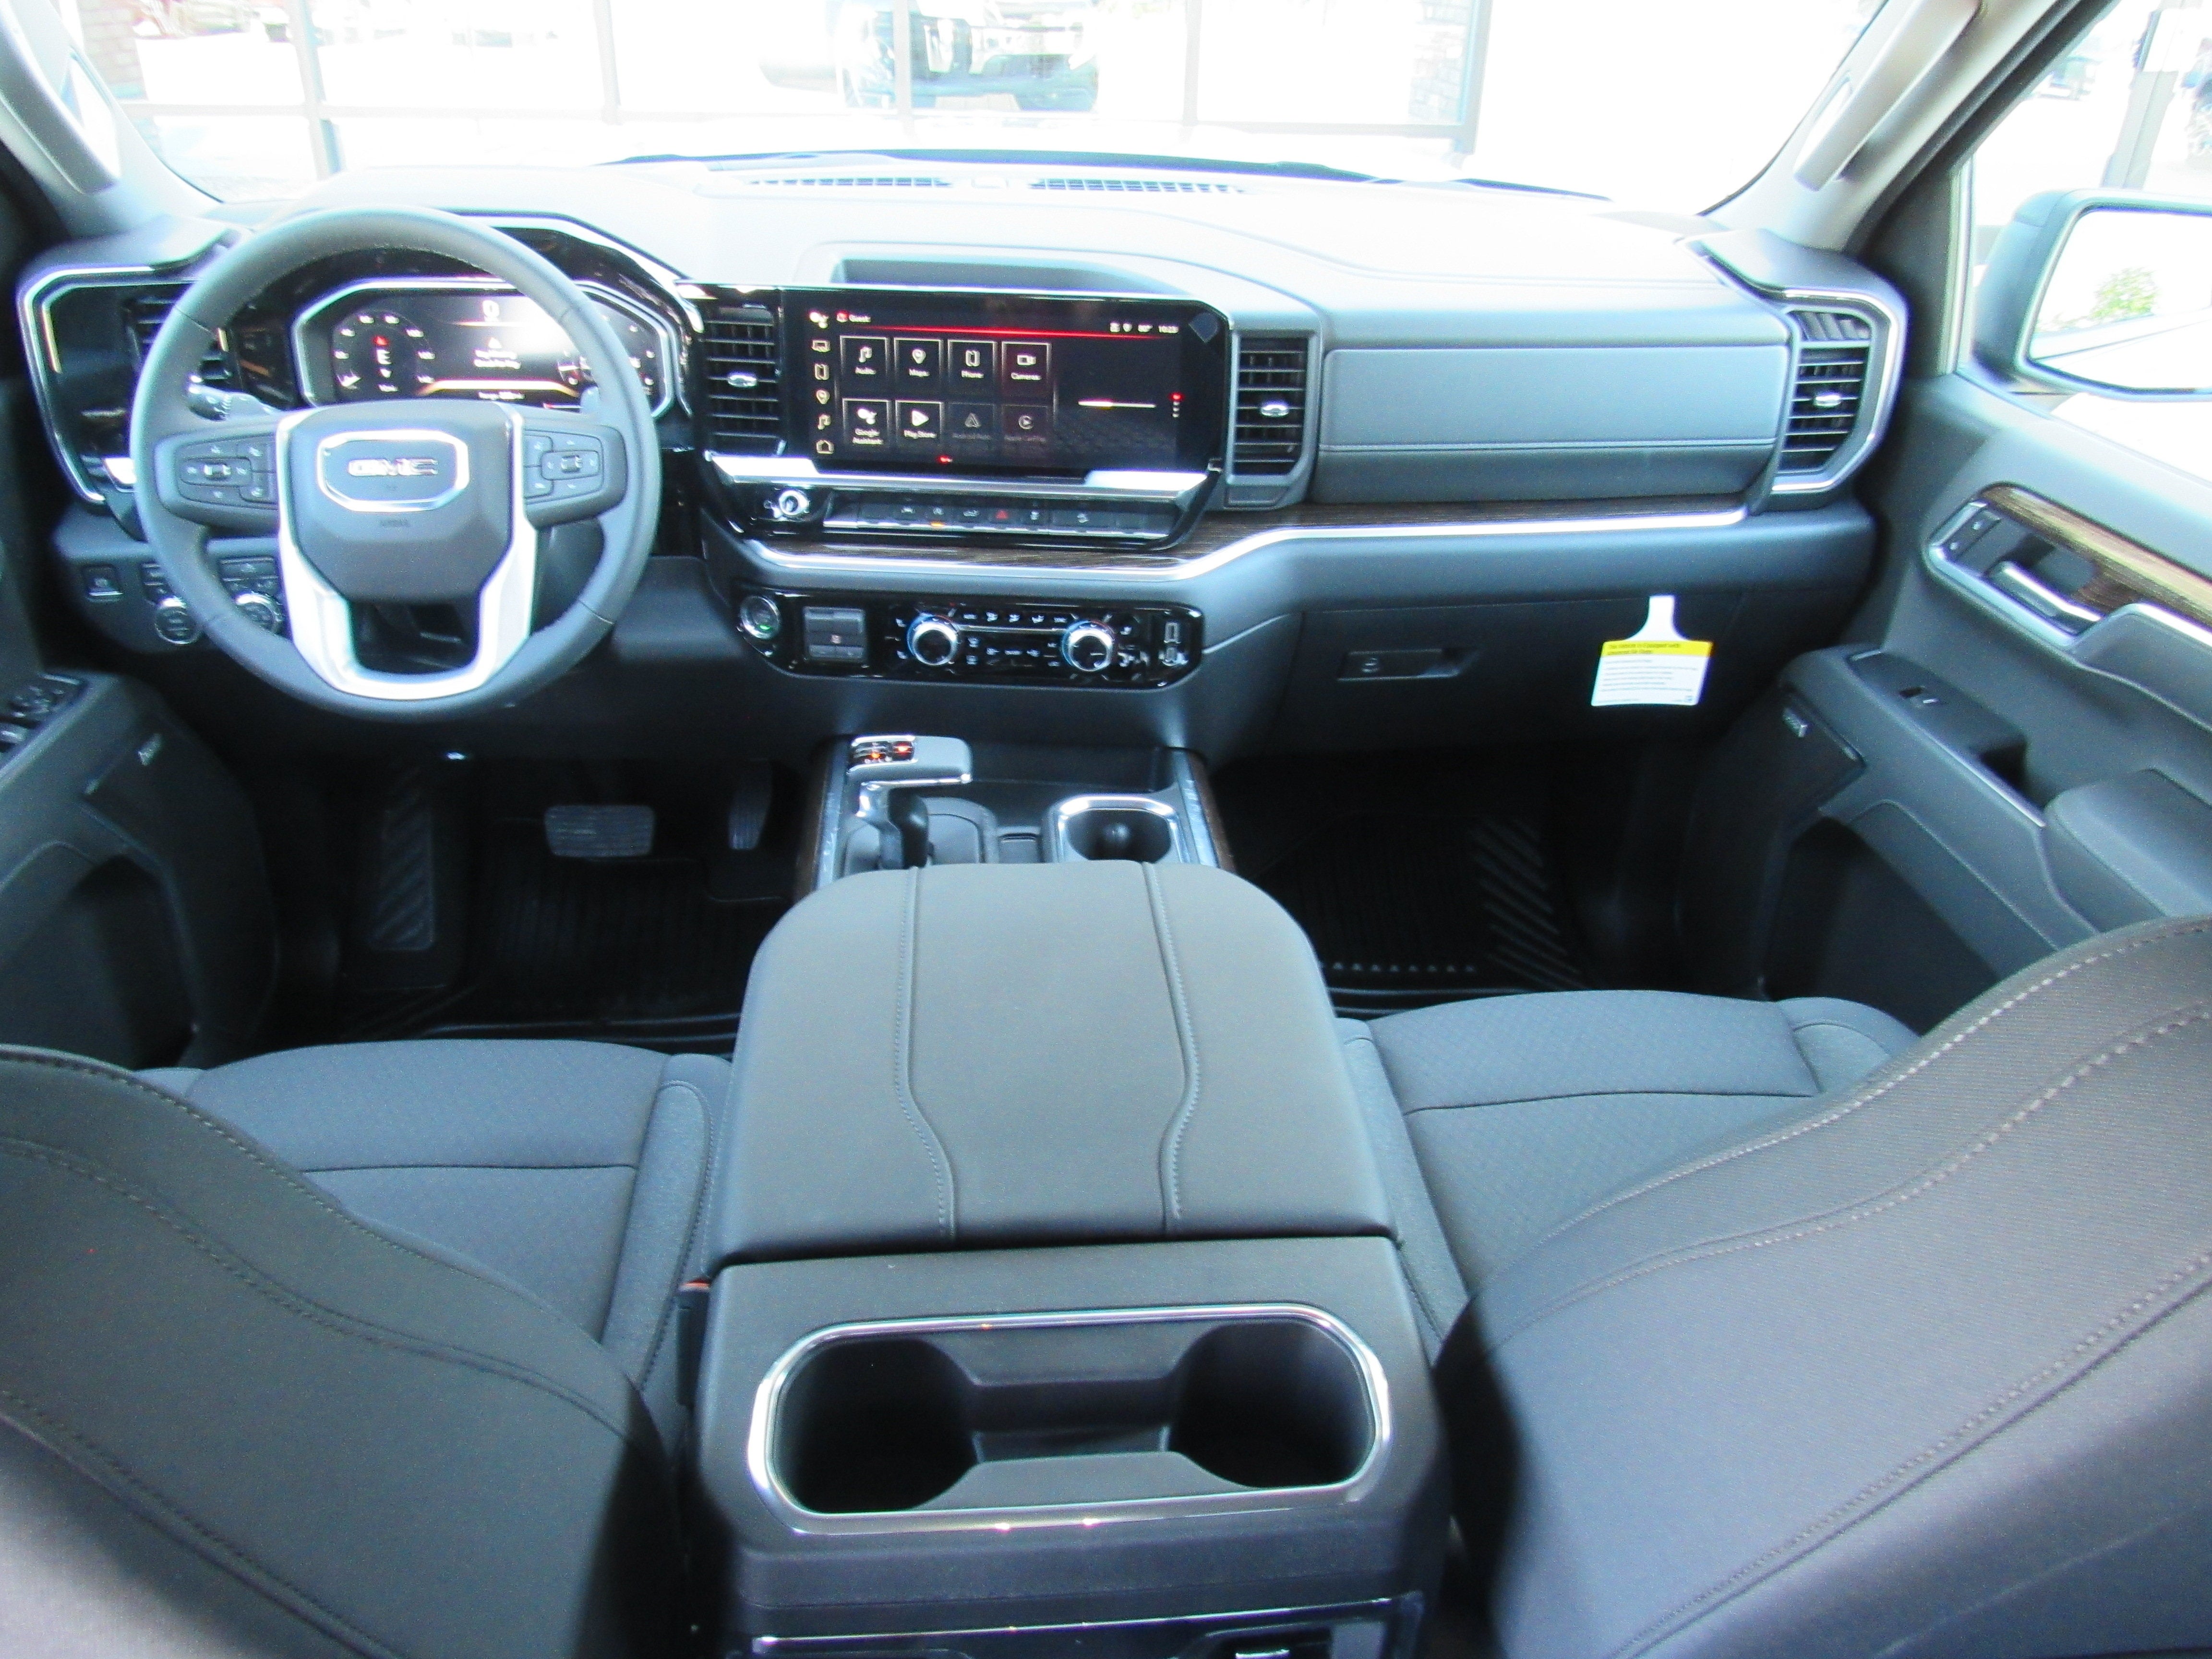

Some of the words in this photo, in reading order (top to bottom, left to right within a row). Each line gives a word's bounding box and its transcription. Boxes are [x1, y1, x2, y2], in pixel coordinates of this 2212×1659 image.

[855, 367, 877, 375] Audio
[909, 368, 930, 378] Maps
[962, 370, 984, 379] Phone
[1011, 373, 1042, 381] Cameras
[855, 428, 880, 437] Google
[853, 436, 884, 445] Assistant
[348, 457, 439, 477] GMC
